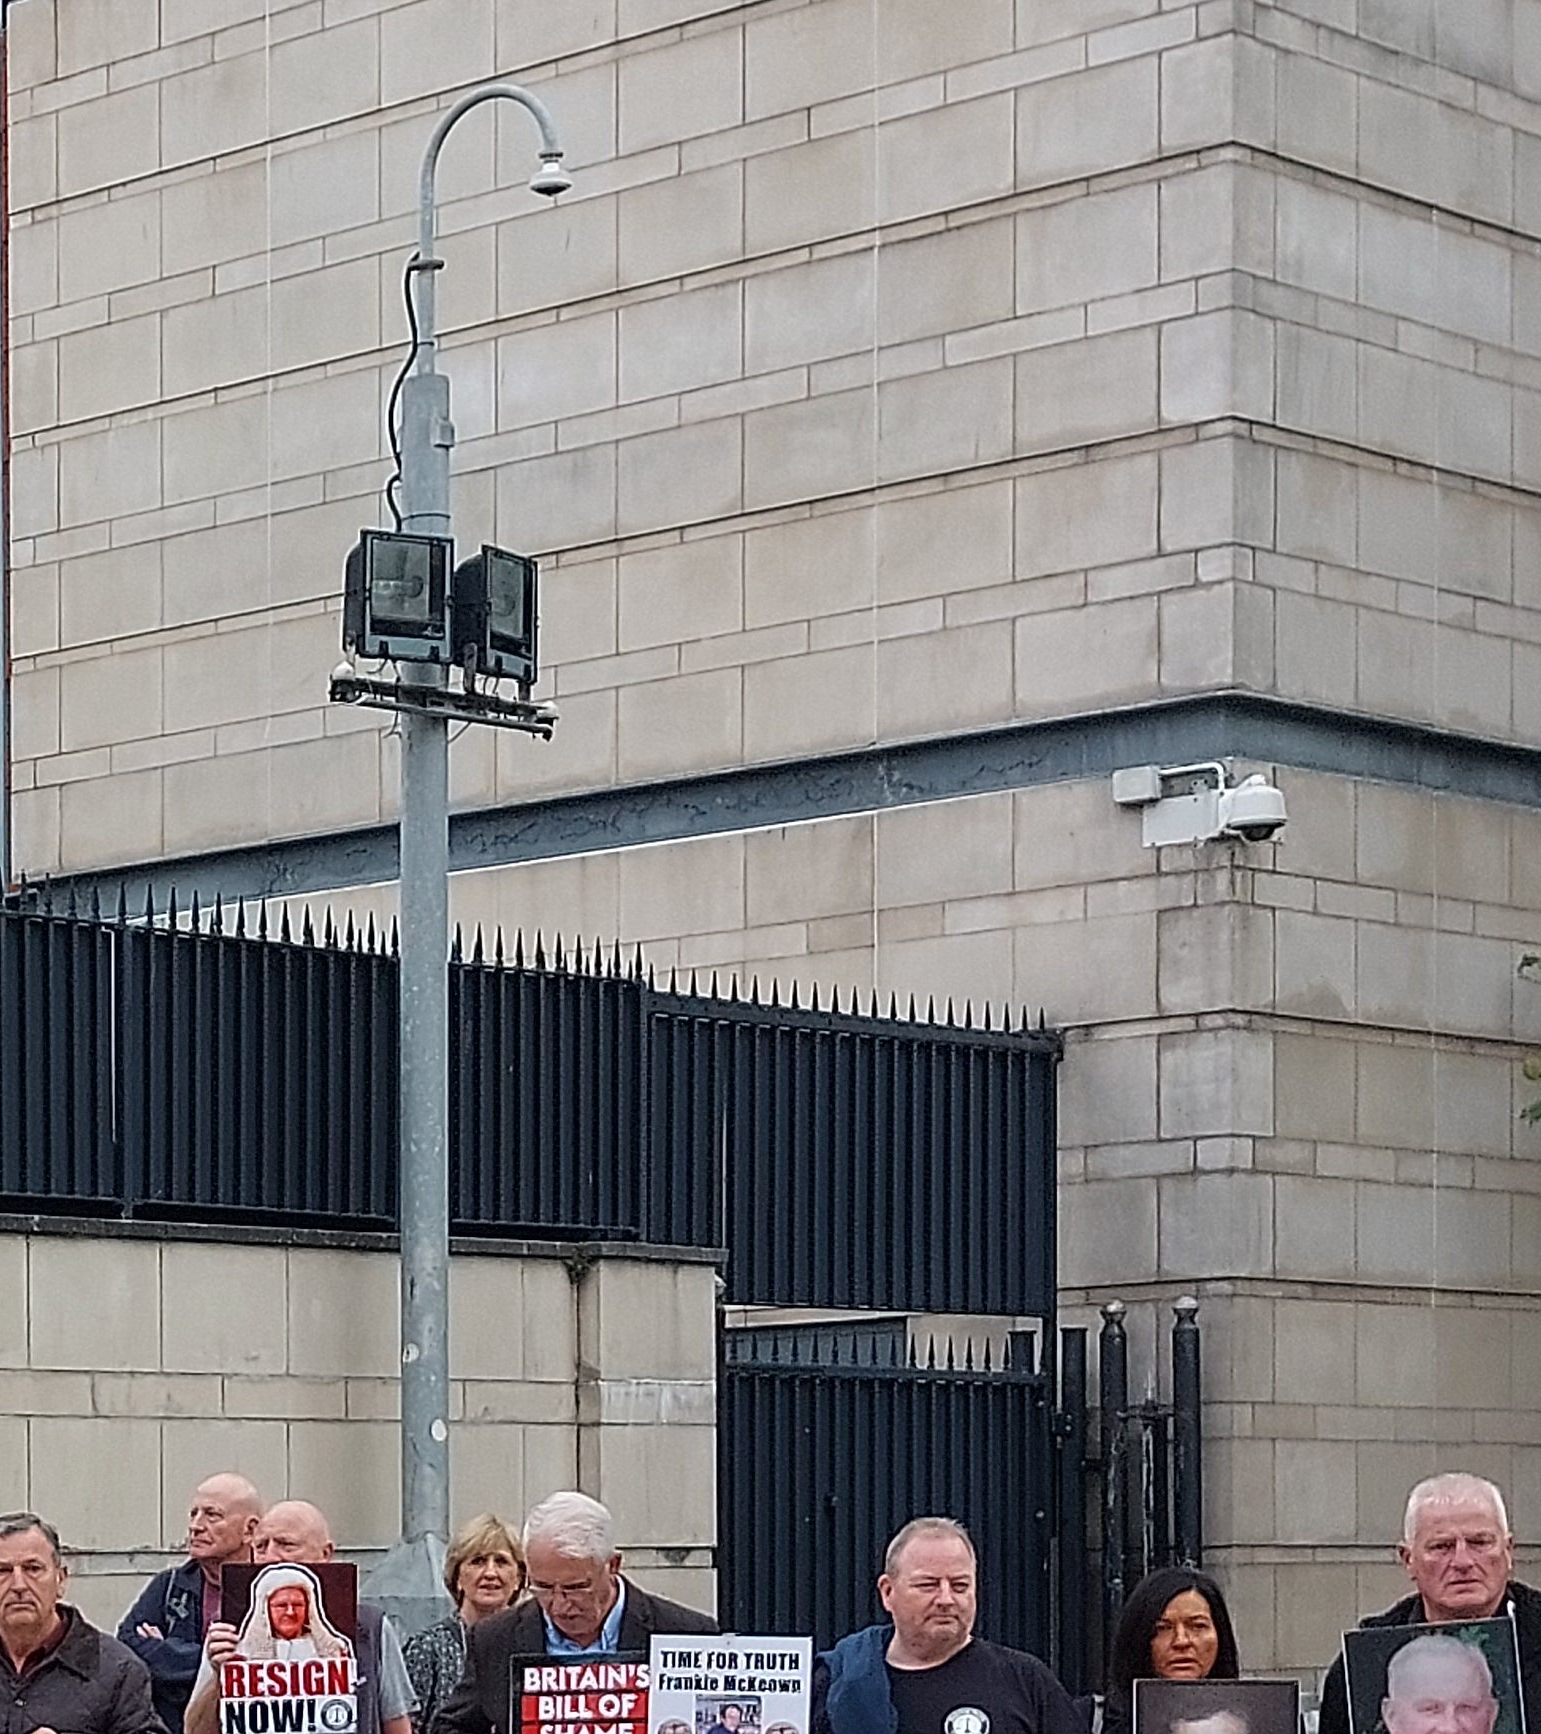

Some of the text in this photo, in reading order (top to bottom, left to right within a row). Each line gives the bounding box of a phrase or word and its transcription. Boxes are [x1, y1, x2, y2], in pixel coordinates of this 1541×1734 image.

[661, 1651, 800, 1670] TIME FOR TRUTH
[223, 1660, 350, 1698] RESIGN
[523, 1664, 651, 1692] BRITAIN'S
[659, 1674, 801, 1694] Frankie McKeown
[225, 1699, 317, 1734] NOW!
[538, 1693, 639, 1721] BILL OF
